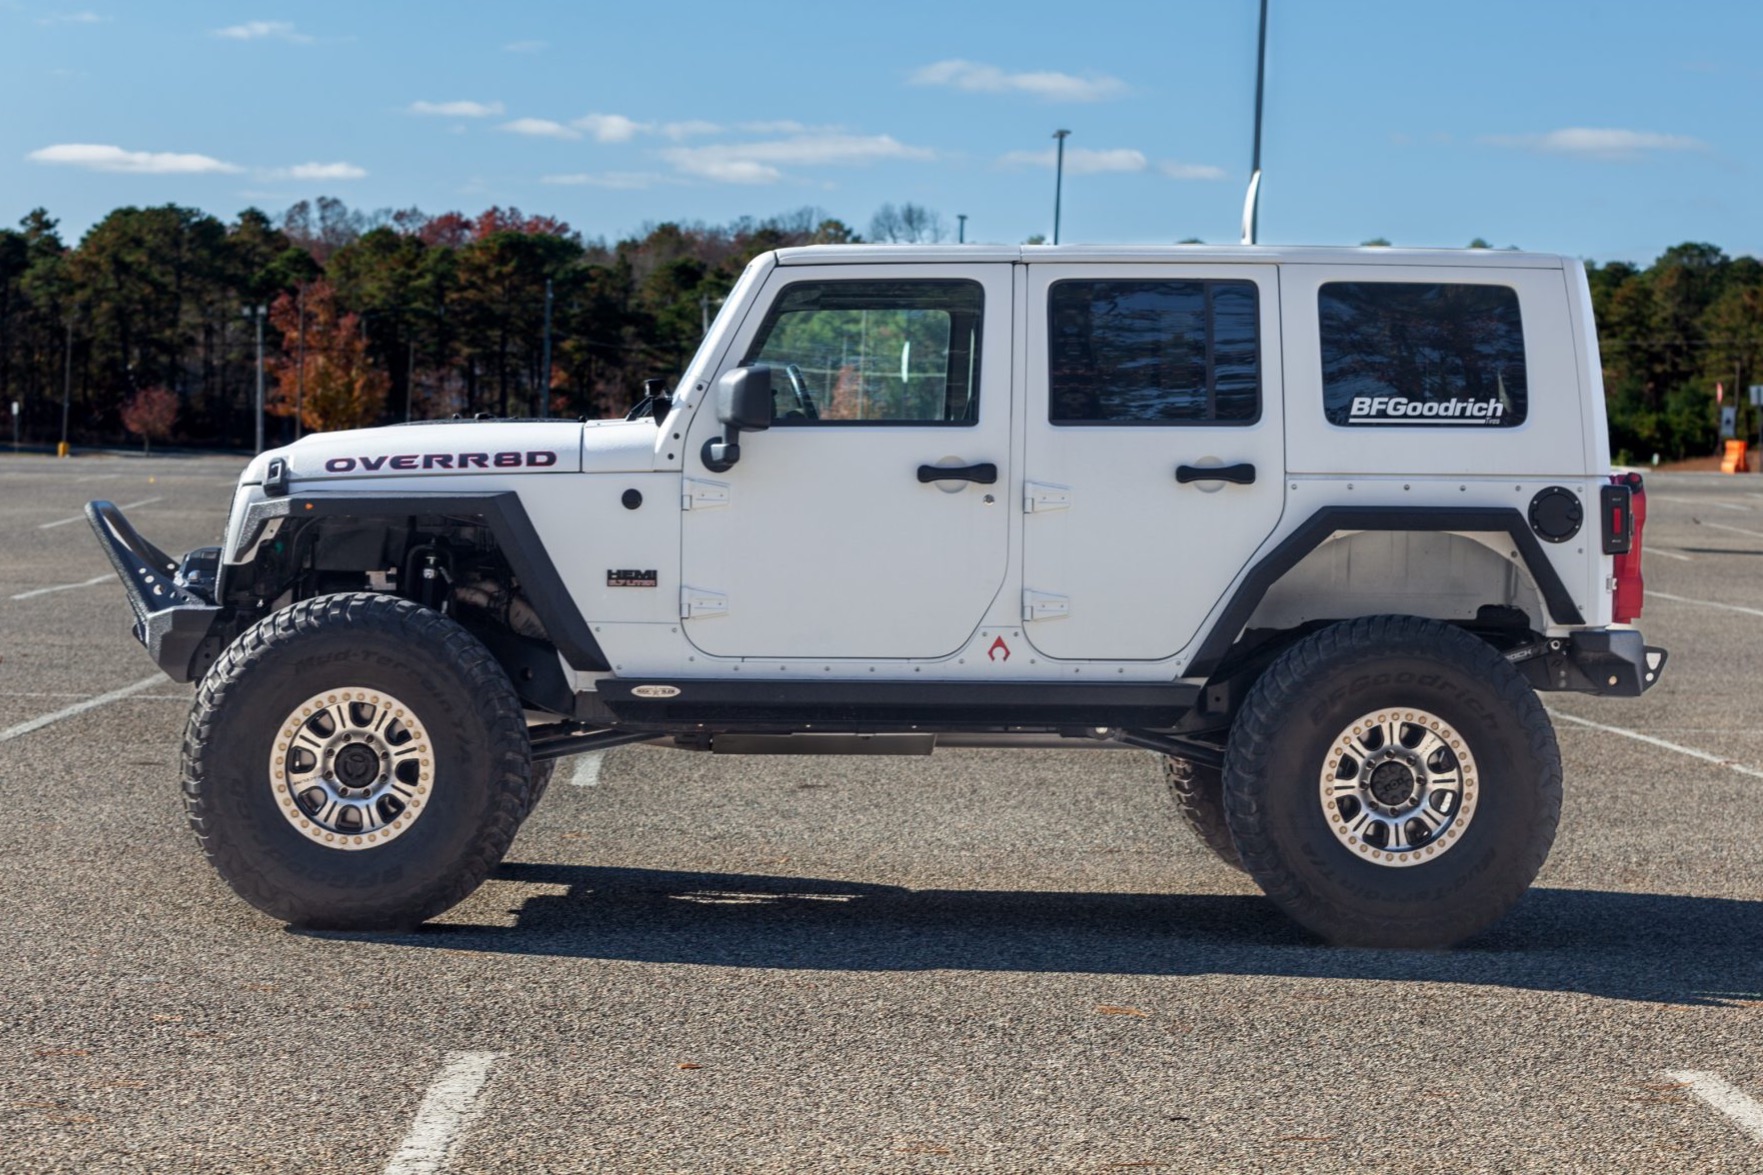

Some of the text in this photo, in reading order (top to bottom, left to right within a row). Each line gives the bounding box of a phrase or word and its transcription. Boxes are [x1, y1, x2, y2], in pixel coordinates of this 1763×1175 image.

[1351, 397, 1503, 417] BFGoodrich
[325, 451, 557, 473] OVERR8D
[607, 569, 657, 580] HEMI
[1309, 671, 1500, 729] BFGoodrich
